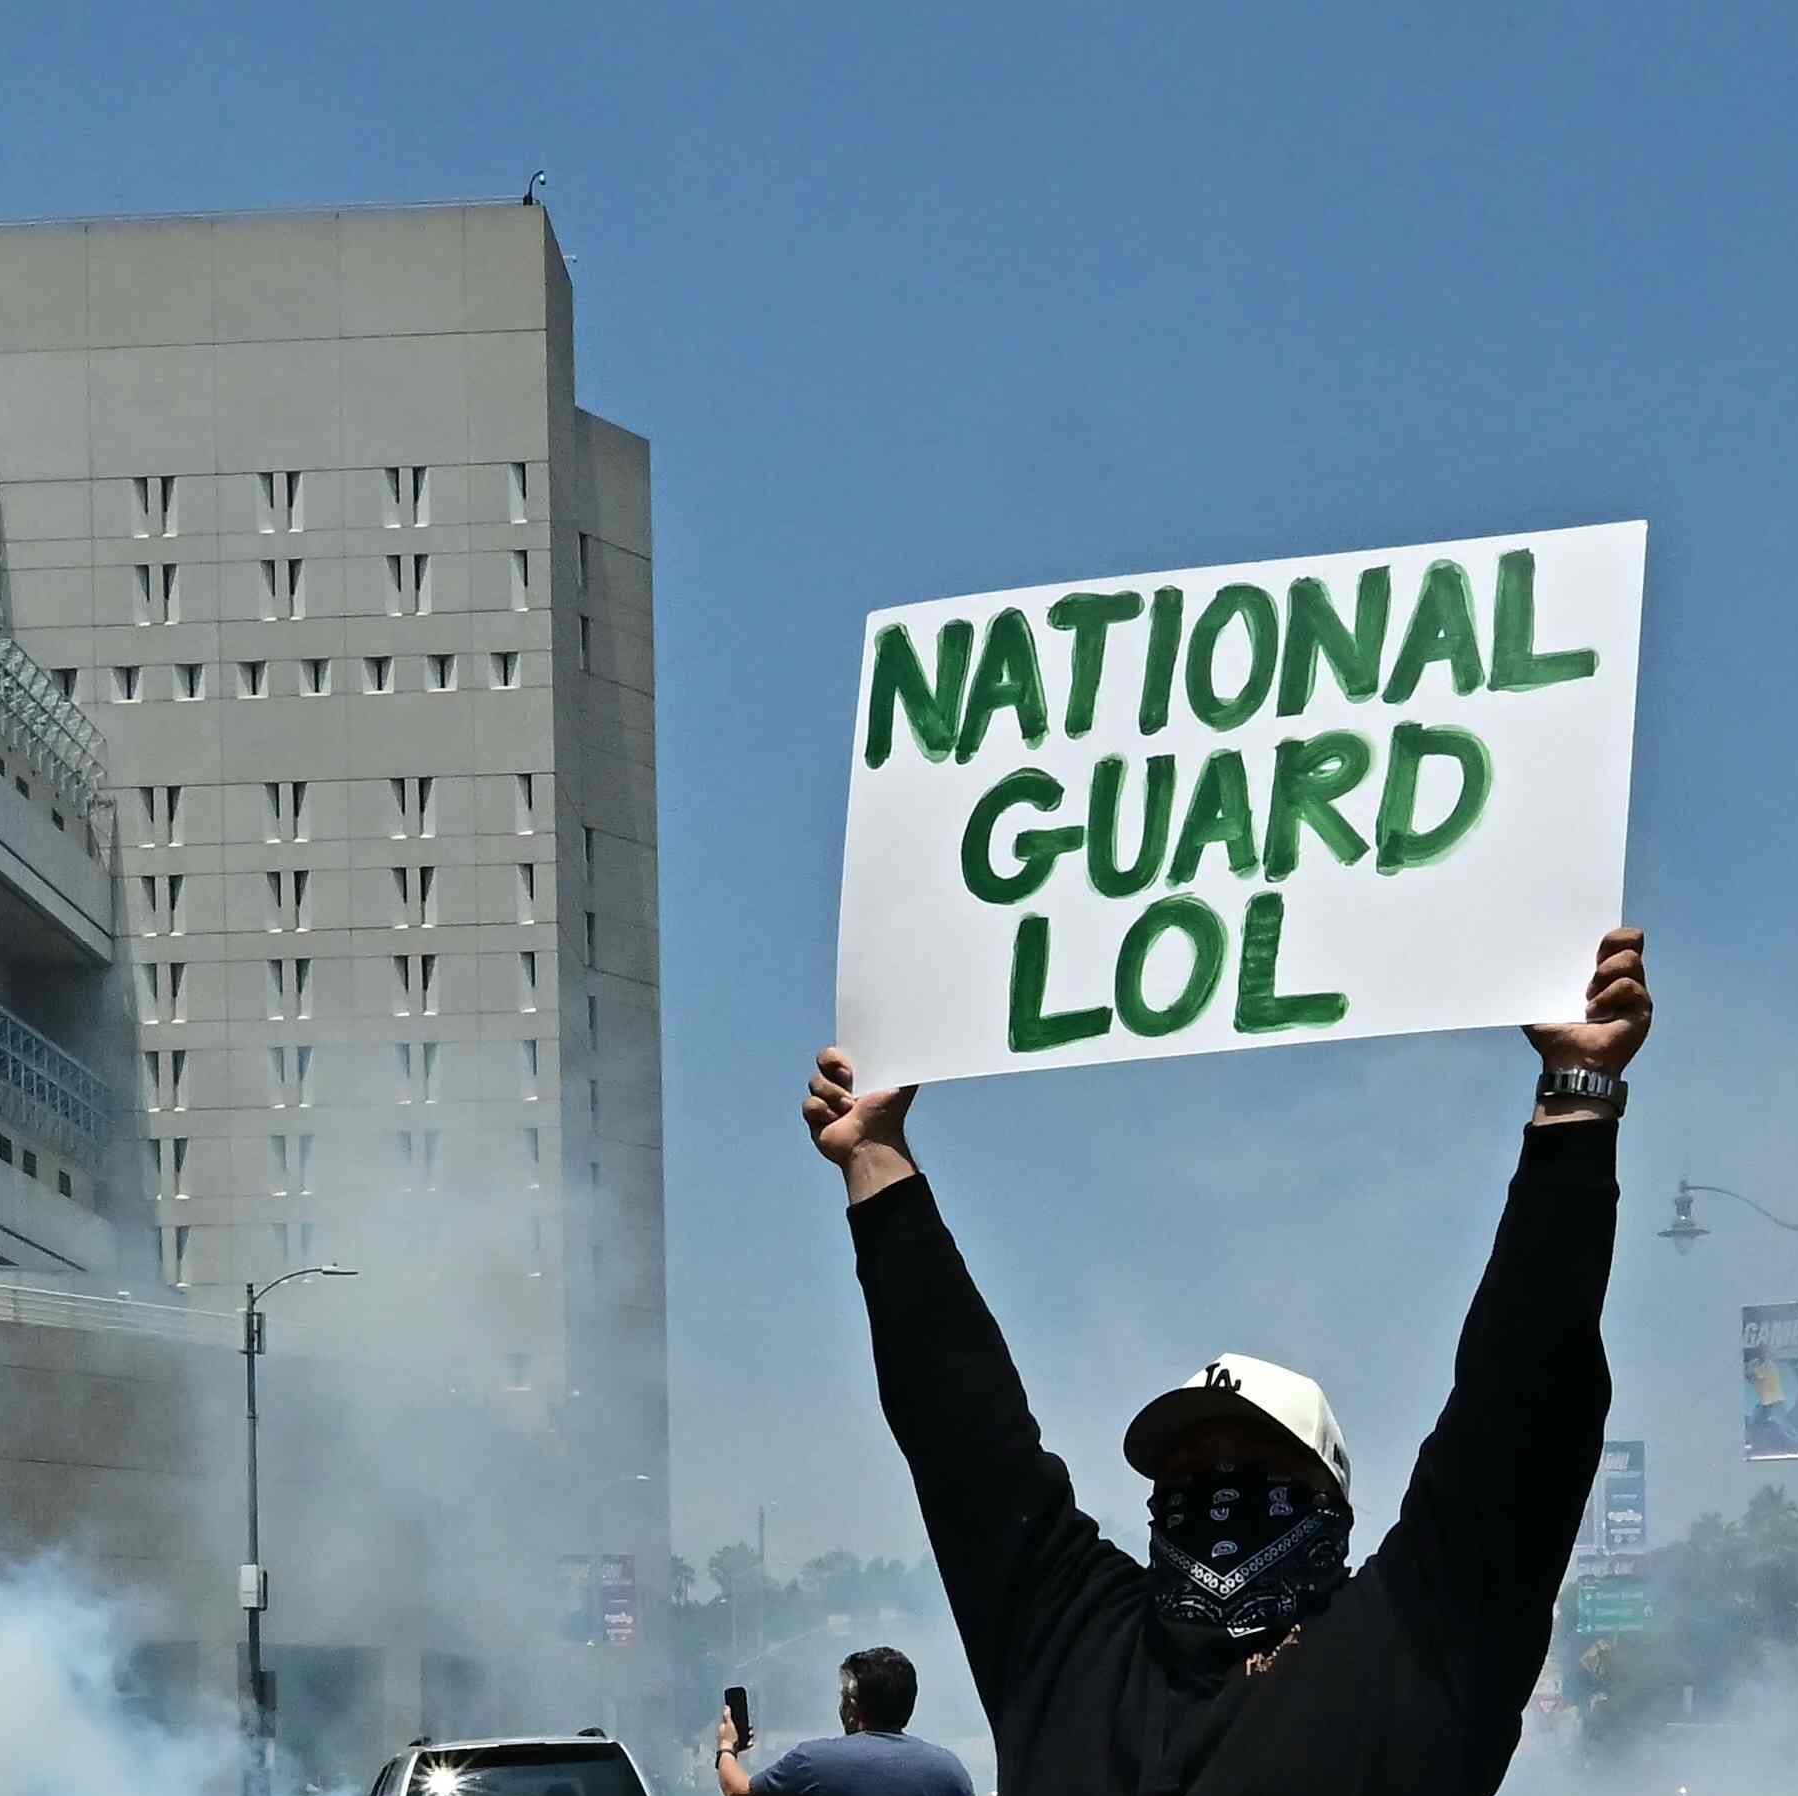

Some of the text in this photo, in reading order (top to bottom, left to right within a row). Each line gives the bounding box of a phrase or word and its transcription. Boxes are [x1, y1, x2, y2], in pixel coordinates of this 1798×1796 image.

[864, 548, 1600, 769] NATIONAL
[960, 721, 1494, 905] GUARD
[1008, 891, 1350, 1054] LOL
